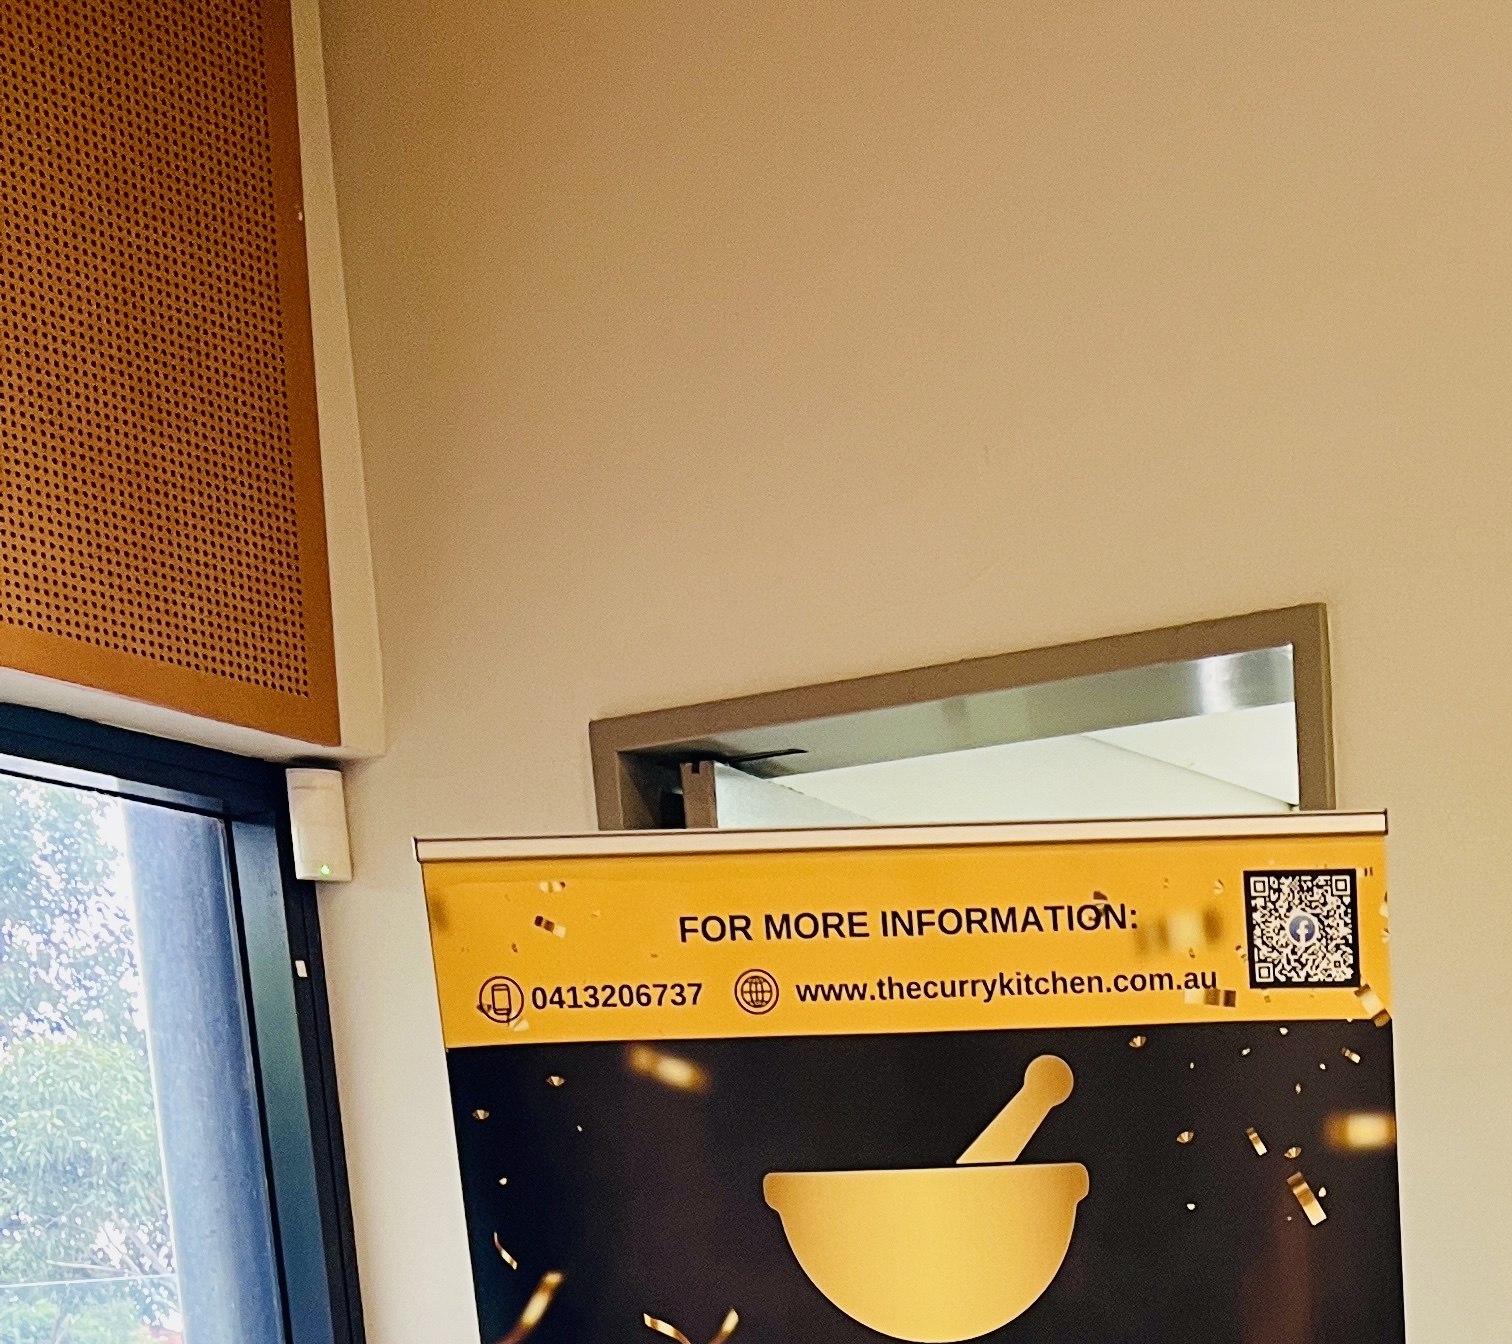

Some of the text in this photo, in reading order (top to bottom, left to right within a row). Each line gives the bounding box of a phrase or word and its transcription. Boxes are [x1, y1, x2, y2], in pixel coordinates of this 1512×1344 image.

[679, 903, 1138, 943] FOR MORE INFORMATION:
[531, 982, 703, 1010] 0413206737
[795, 970, 1220, 1003] www.thecurrykitchen.com.au
